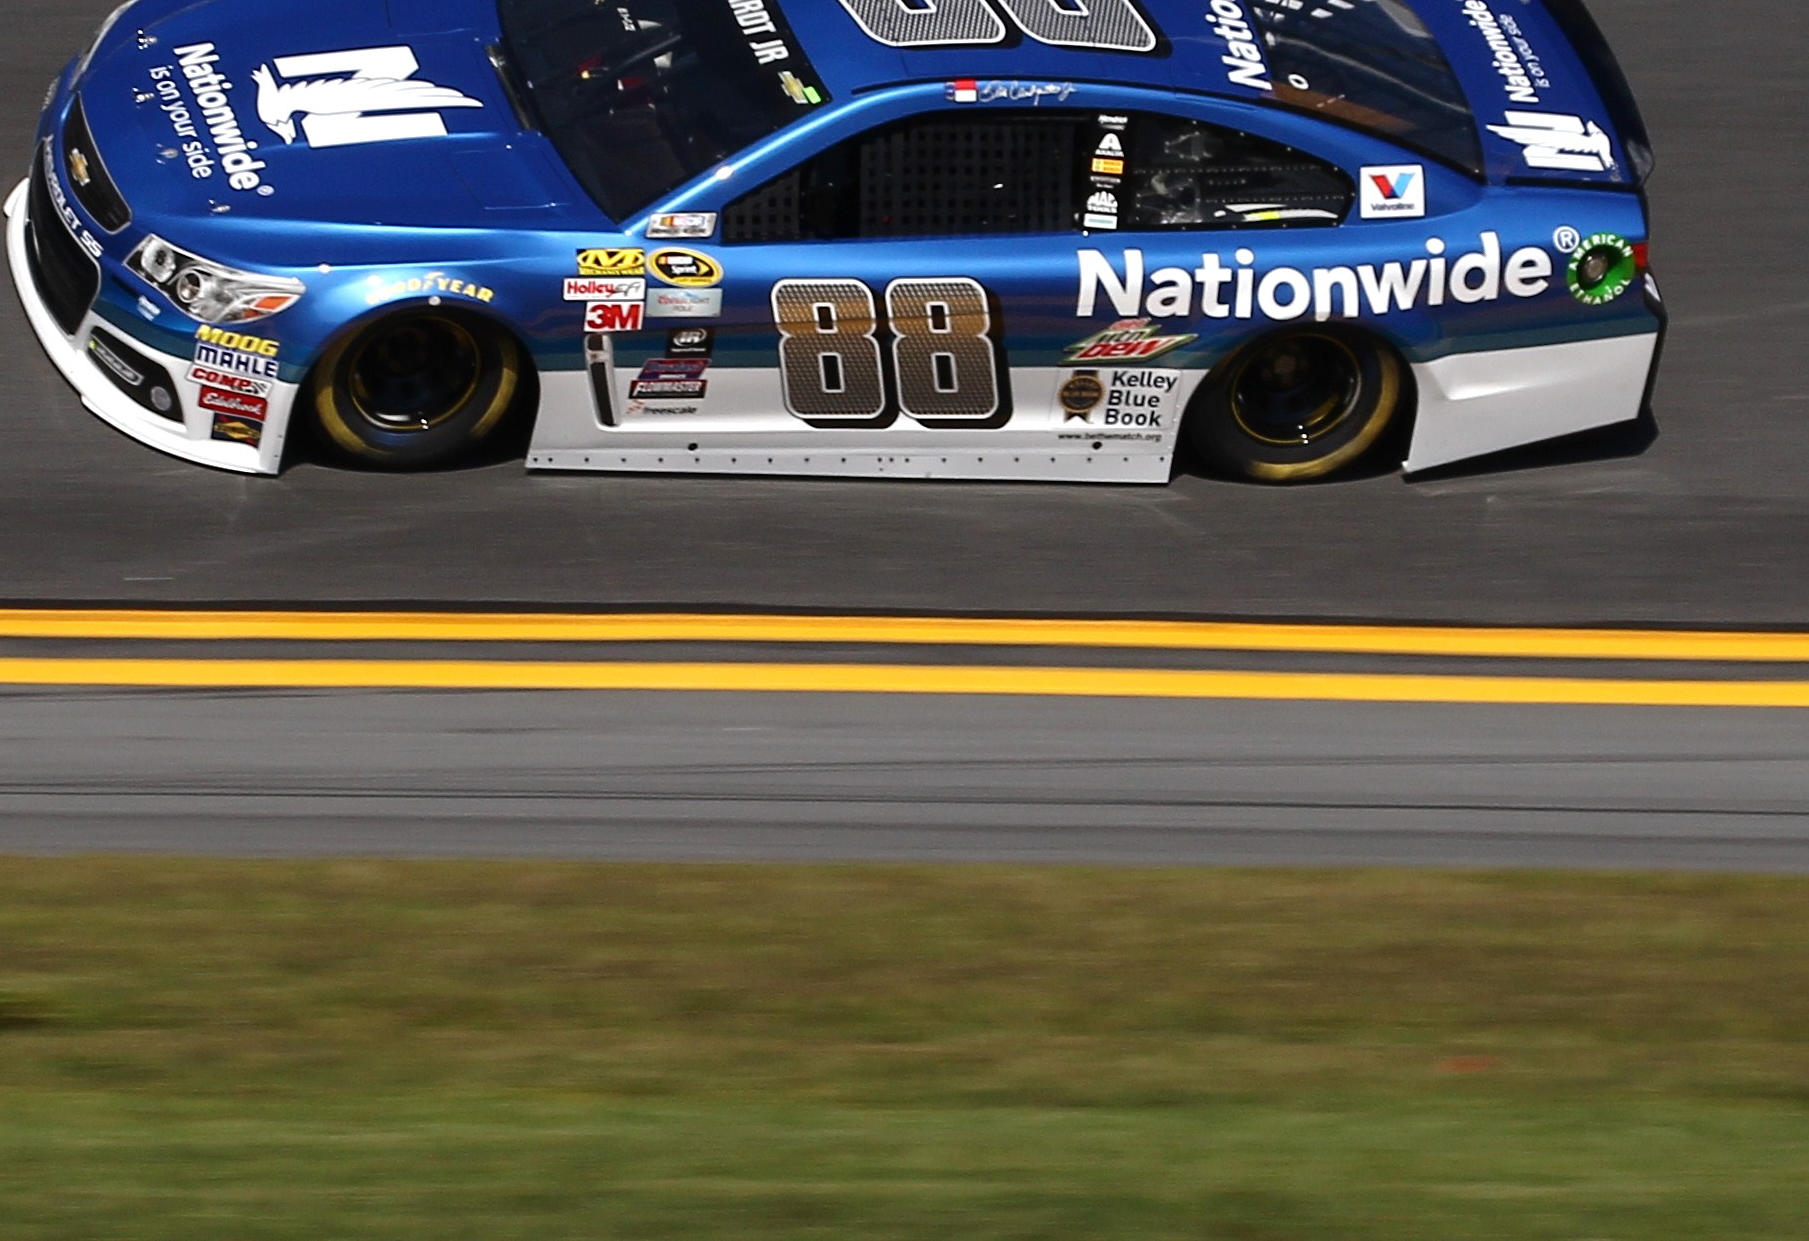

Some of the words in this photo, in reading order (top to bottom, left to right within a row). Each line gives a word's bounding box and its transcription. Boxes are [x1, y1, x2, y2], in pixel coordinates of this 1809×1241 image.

[749, 39, 789, 64] JR
[1461, 0, 1540, 103] Nationwide
[148, 65, 175, 80] is
[155, 80, 181, 101] on
[160, 100, 198, 138] your
[182, 141, 215, 179] side
[1371, 203, 1415, 211] Valvoline
[80, 230, 104, 258] SS
[1569, 234, 1634, 271] AMERICAN
[567, 280, 615, 298] Holley
[1569, 278, 1632, 305] ETHANOL
[587, 304, 641, 330] 3M
[195, 324, 280, 357] MOOG
[771, 277, 1001, 421] 88
[197, 345, 278, 378] MAHLE
[192, 367, 253, 389] COMP
[1111, 370, 1177, 393] Kelley
[1108, 390, 1160, 407] Blue
[1105, 409, 1163, 427] Book
